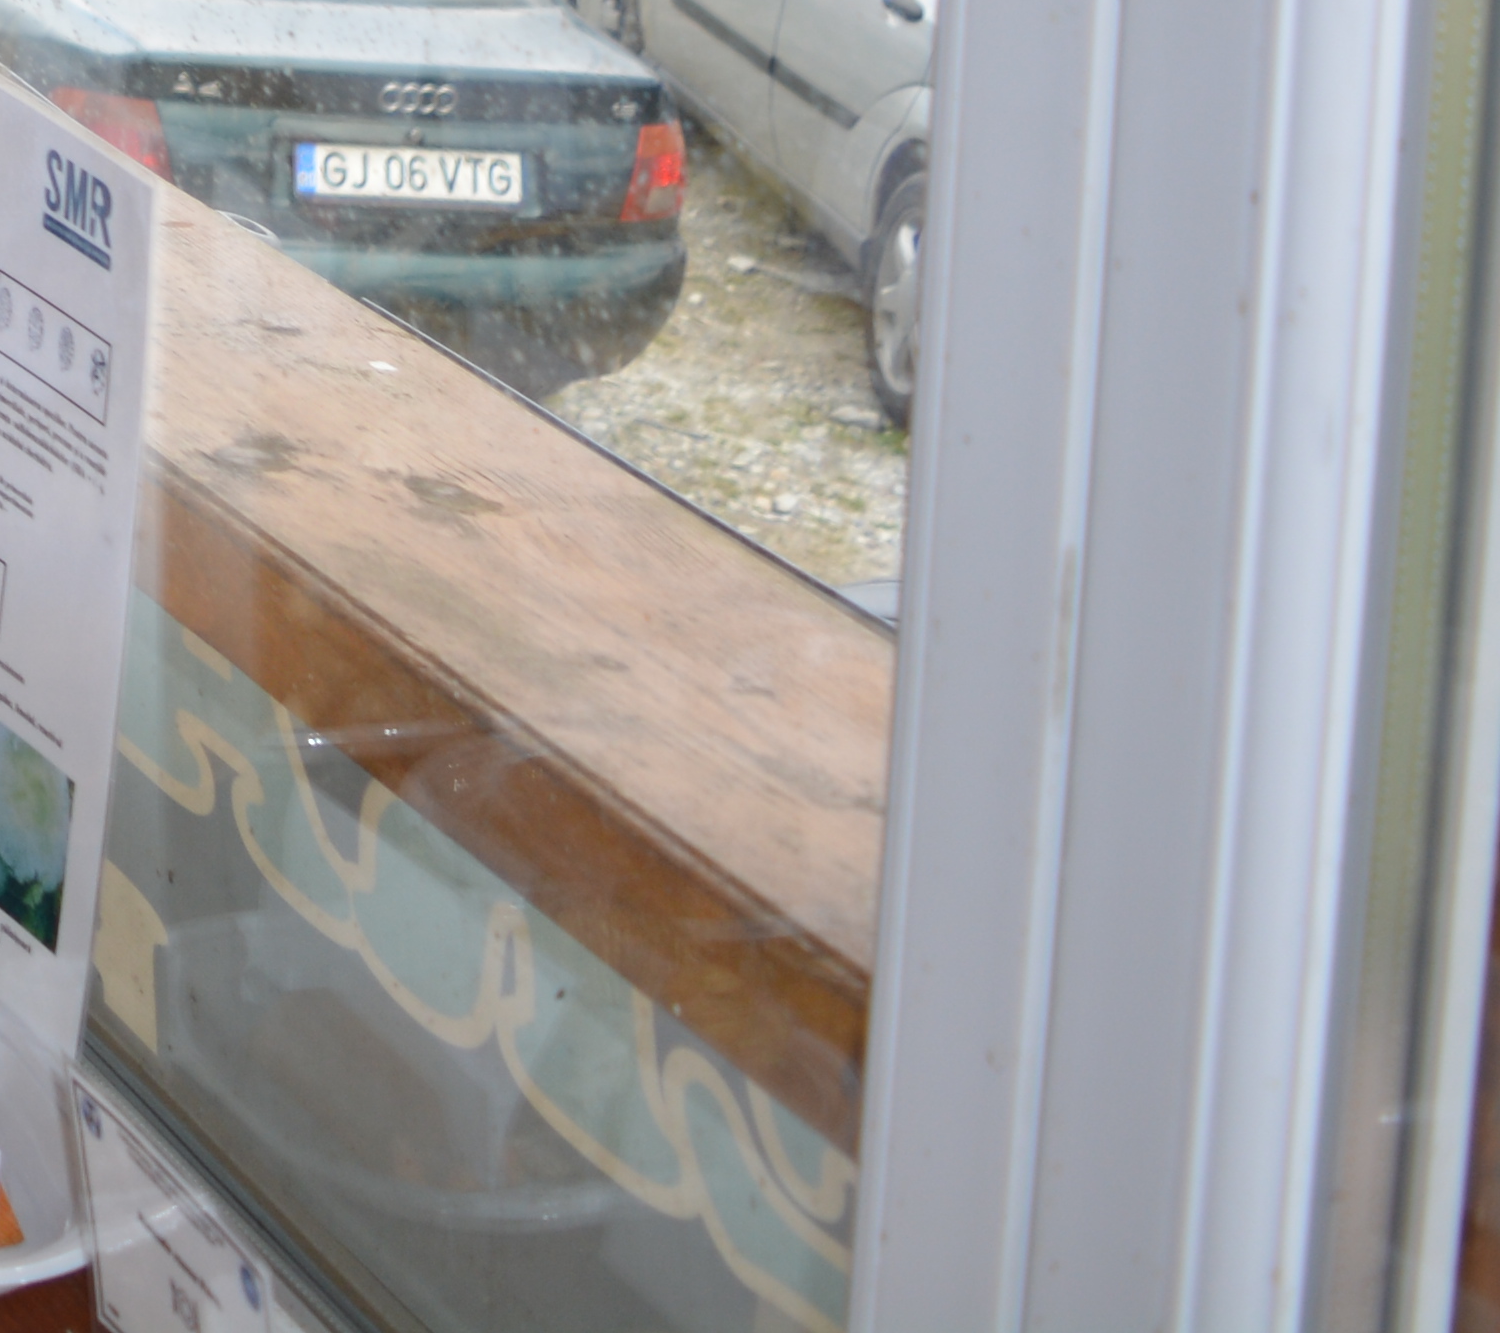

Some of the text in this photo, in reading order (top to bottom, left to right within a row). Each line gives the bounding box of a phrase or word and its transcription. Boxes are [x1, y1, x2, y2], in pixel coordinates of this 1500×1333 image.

[43, 148, 112, 250] SMR
[321, 151, 369, 189] GJ
[384, 155, 428, 192] 06
[439, 156, 513, 195] VTG
